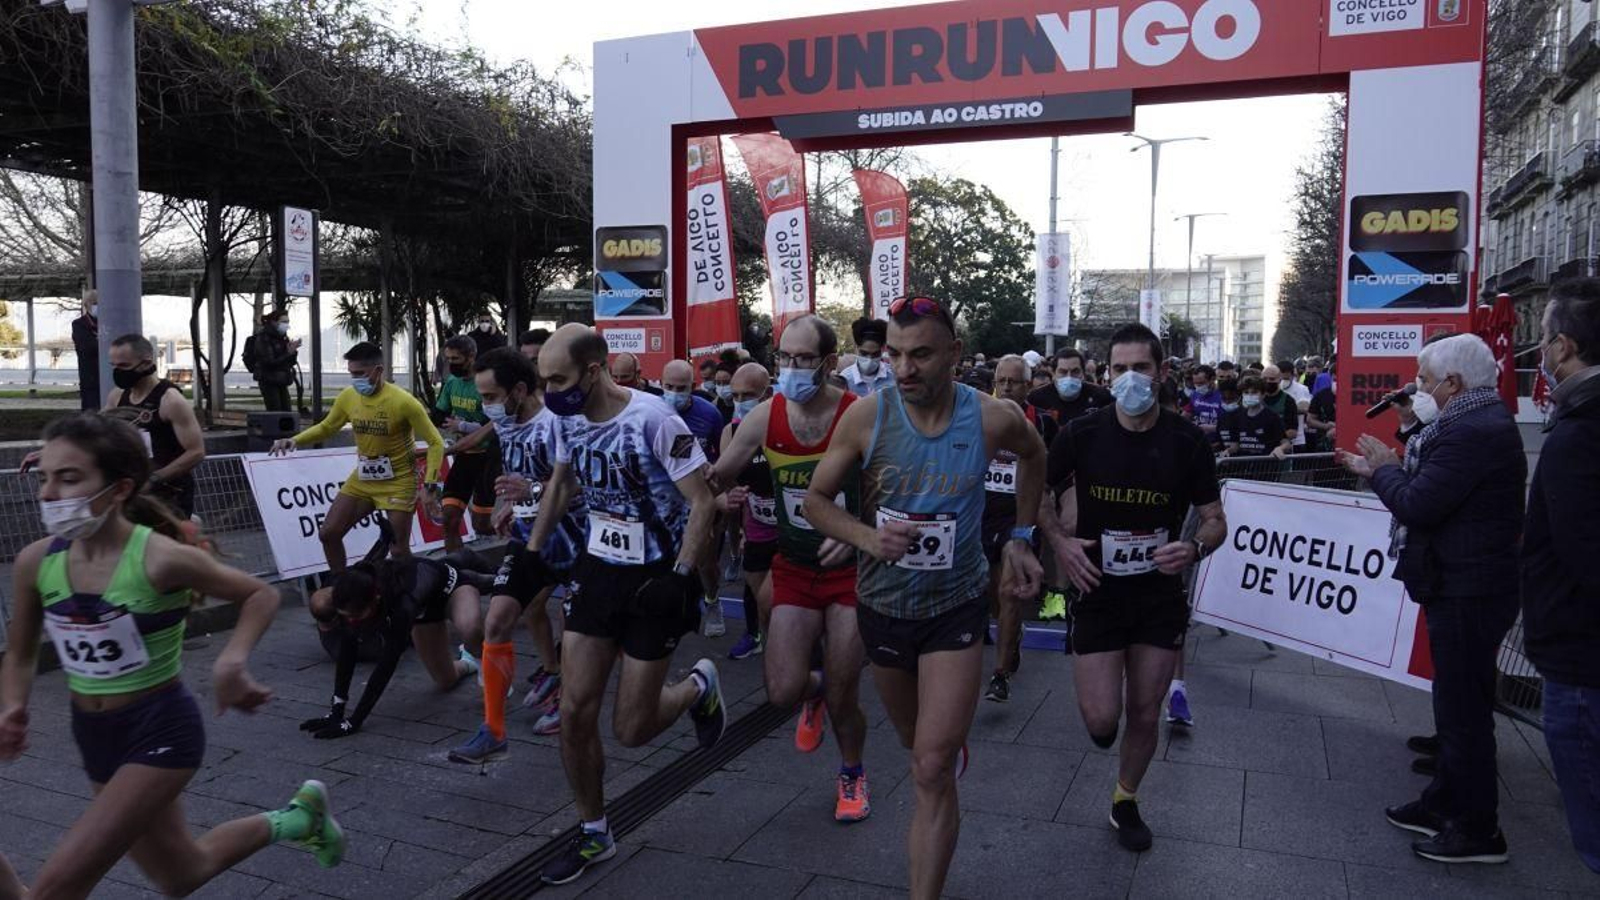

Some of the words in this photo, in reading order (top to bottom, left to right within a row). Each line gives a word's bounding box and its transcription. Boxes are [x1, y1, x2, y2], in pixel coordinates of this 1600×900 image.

[1346, 13, 1365, 25] DE
[1371, 9, 1407, 22] VIGO
[858, 109, 927, 130] SUBIDA
[930, 107, 957, 124] AO
[961, 102, 1043, 122] CASTRO
[1360, 207, 1459, 235] GADIS
[602, 238, 662, 258] GADIS
[1353, 273, 1460, 285] POWERADE
[598, 288, 664, 298] POWERADE
[606, 332, 642, 341] CONCELLO
[1357, 331, 1417, 340] CONCELLO
[610, 340, 619, 348] DE
[622, 340, 638, 348] VIGO
[1364, 341, 1379, 350] DE
[1383, 341, 1410, 350] VIGO
[1351, 374, 1399, 389] RUN
[362, 465, 386, 474] 456
[777, 469, 811, 485] BIK
[985, 471, 1013, 484] 308
[1089, 485, 1171, 505] ATHLETICS
[600, 528, 630, 551] 481
[1234, 525, 1384, 579] CONCELLO
[1241, 563, 1278, 595] DE
[1289, 573, 1357, 615] VIGO
[64, 640, 123, 663] 623
